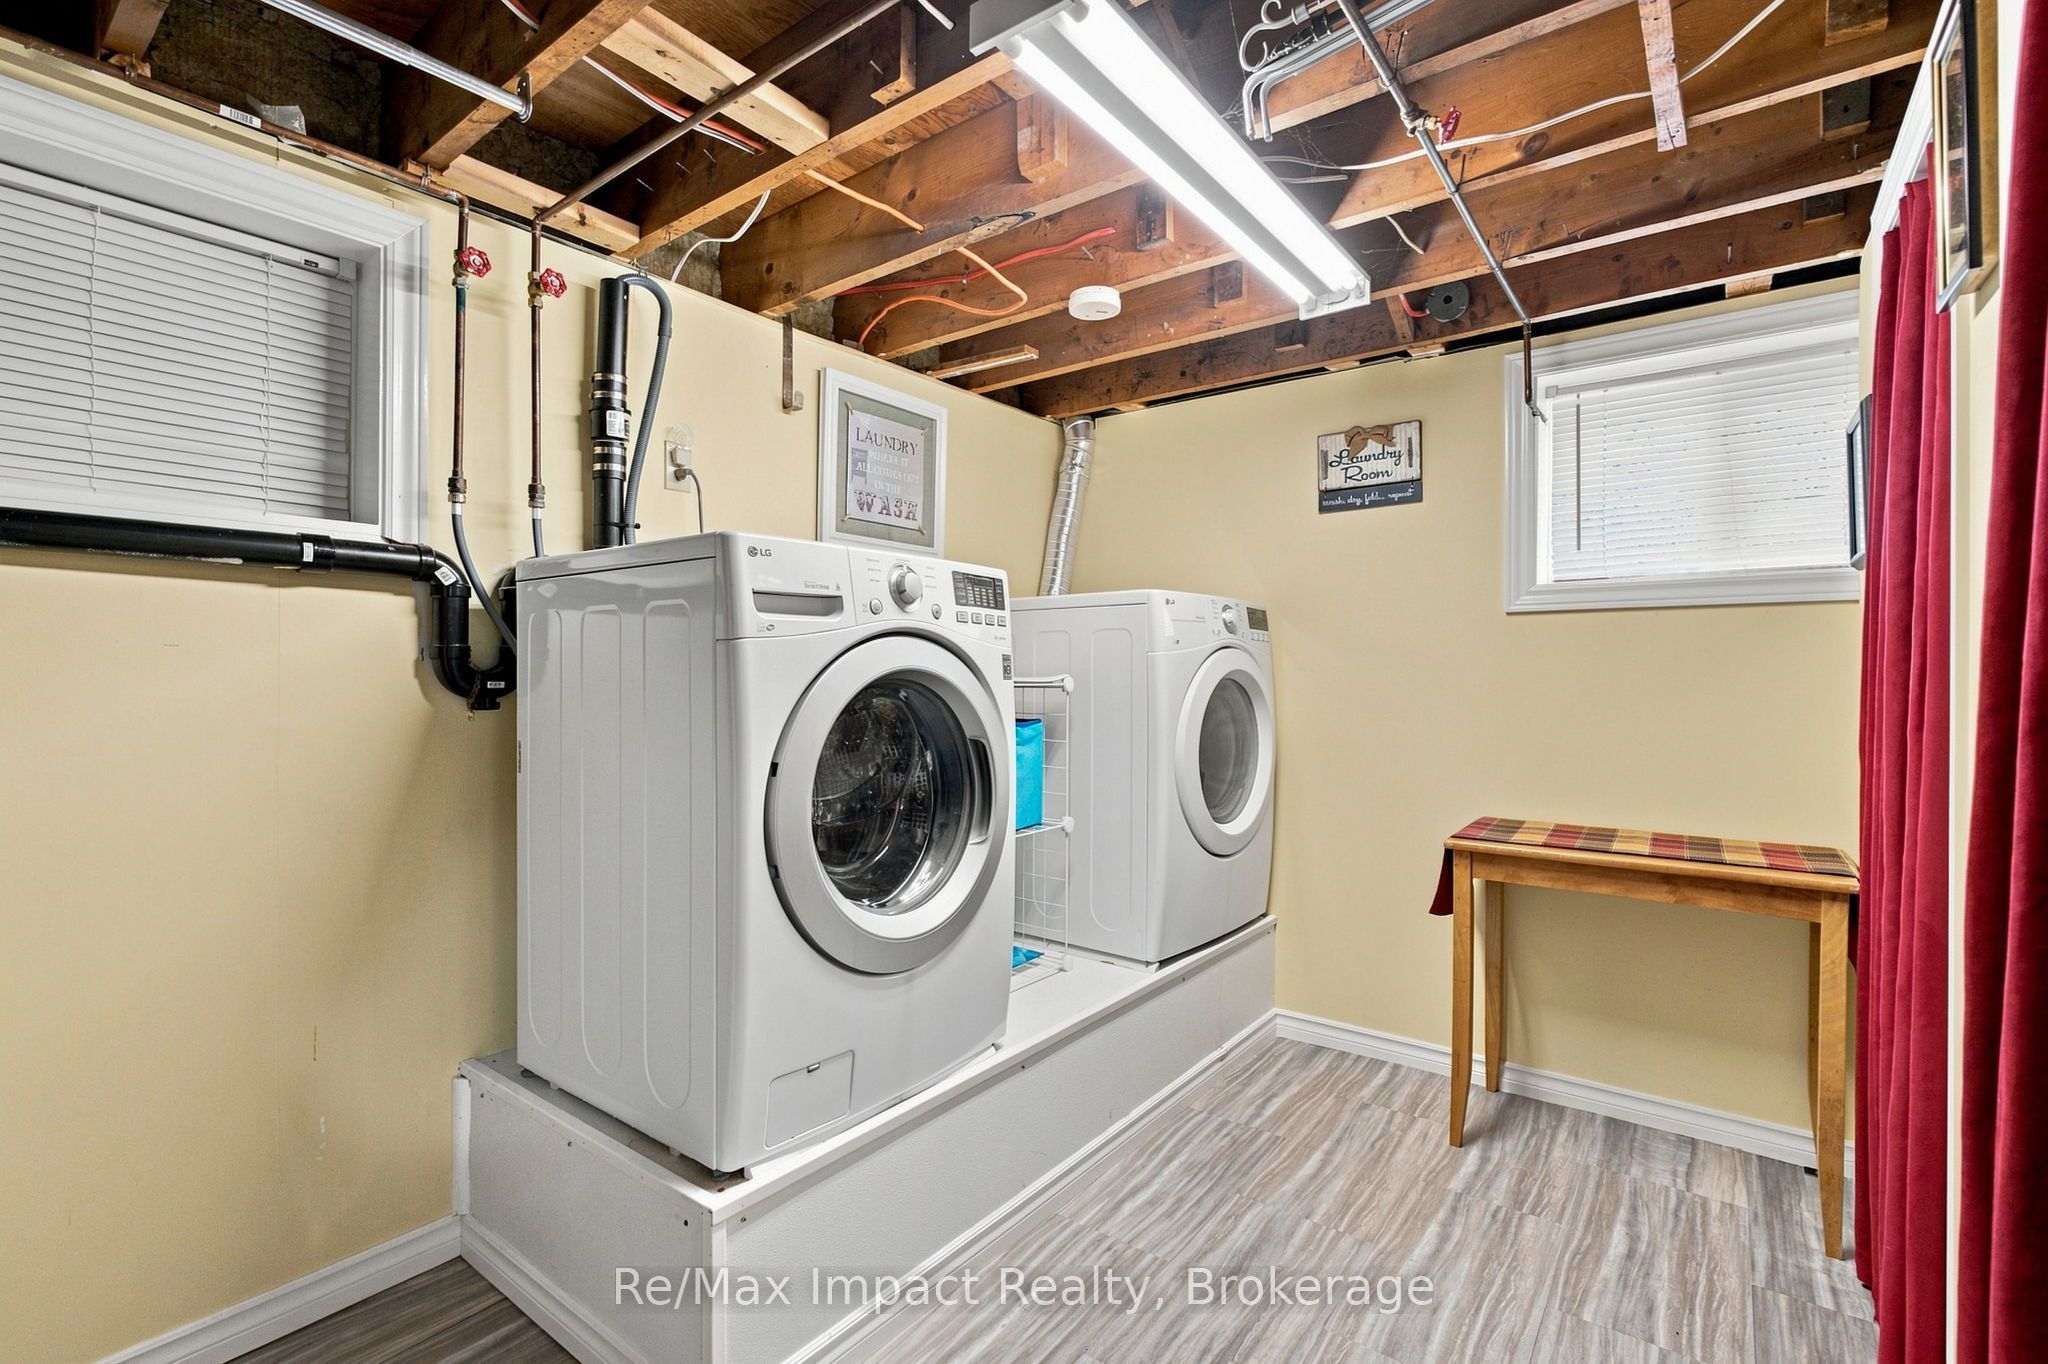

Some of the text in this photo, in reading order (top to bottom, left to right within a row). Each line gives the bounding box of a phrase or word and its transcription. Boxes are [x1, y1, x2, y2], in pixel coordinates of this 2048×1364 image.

[1329, 444, 1404, 467] Laundry
[1340, 465, 1393, 483] Room
[854, 489, 918, 521] WASH
